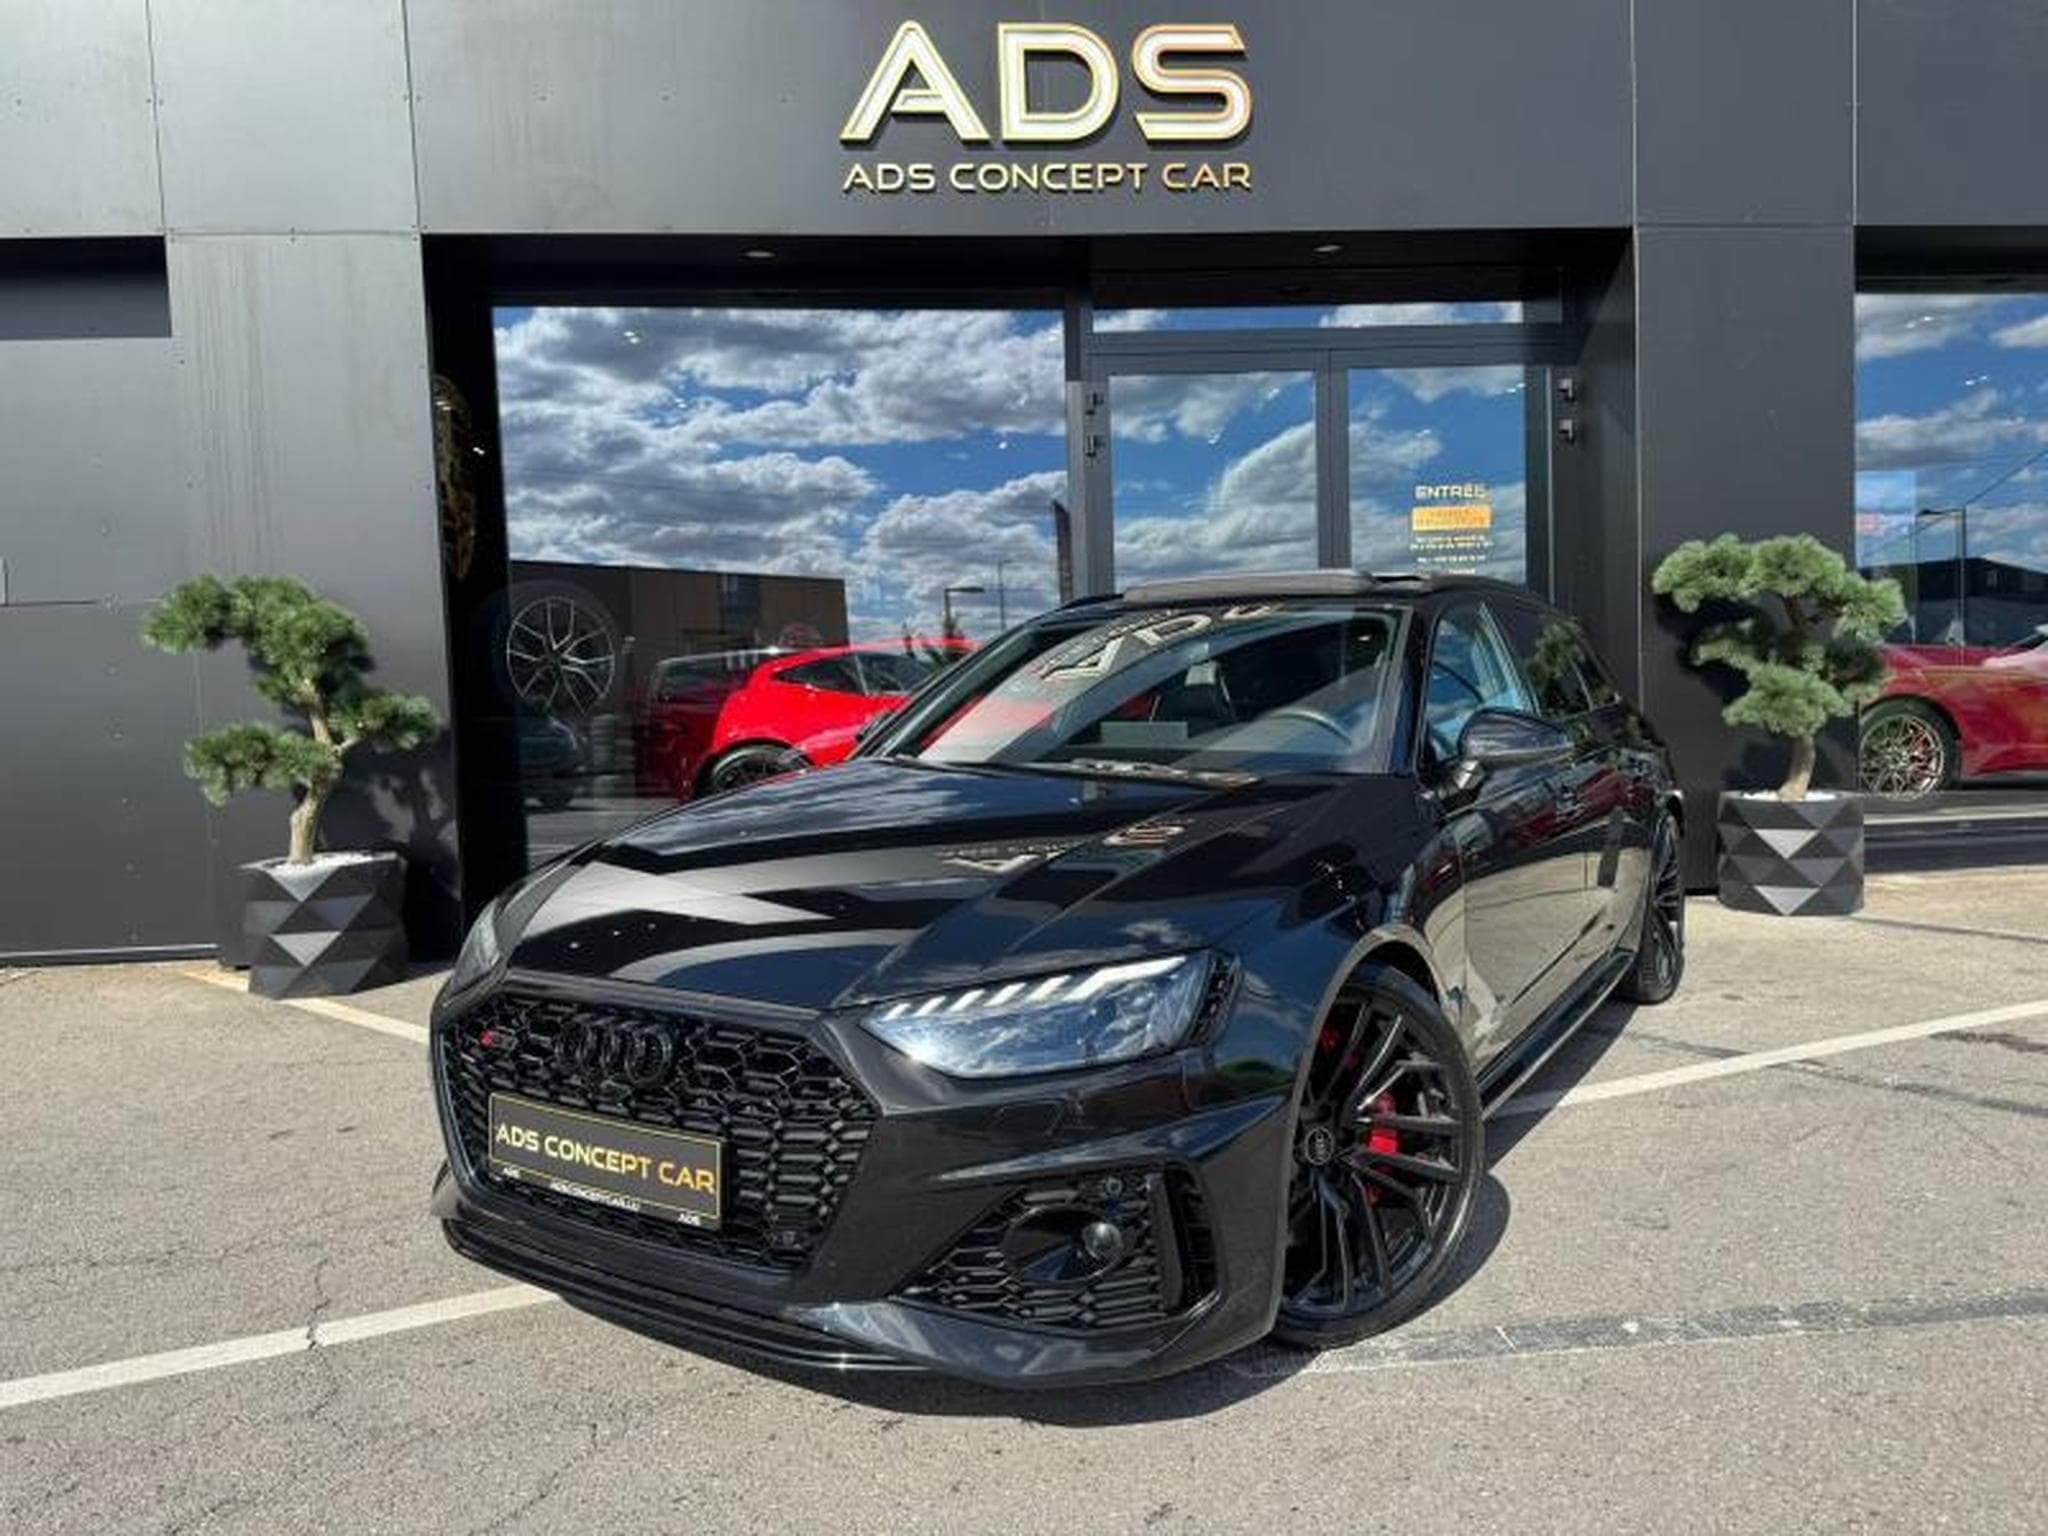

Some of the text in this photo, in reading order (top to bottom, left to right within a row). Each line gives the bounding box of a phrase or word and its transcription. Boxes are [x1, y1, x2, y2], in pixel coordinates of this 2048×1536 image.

[840, 20, 1252, 142] ADS
[842, 162, 1252, 191] ADS CONCEPT CAR
[495, 1122, 715, 1194] ADS CONCEPT CAR
